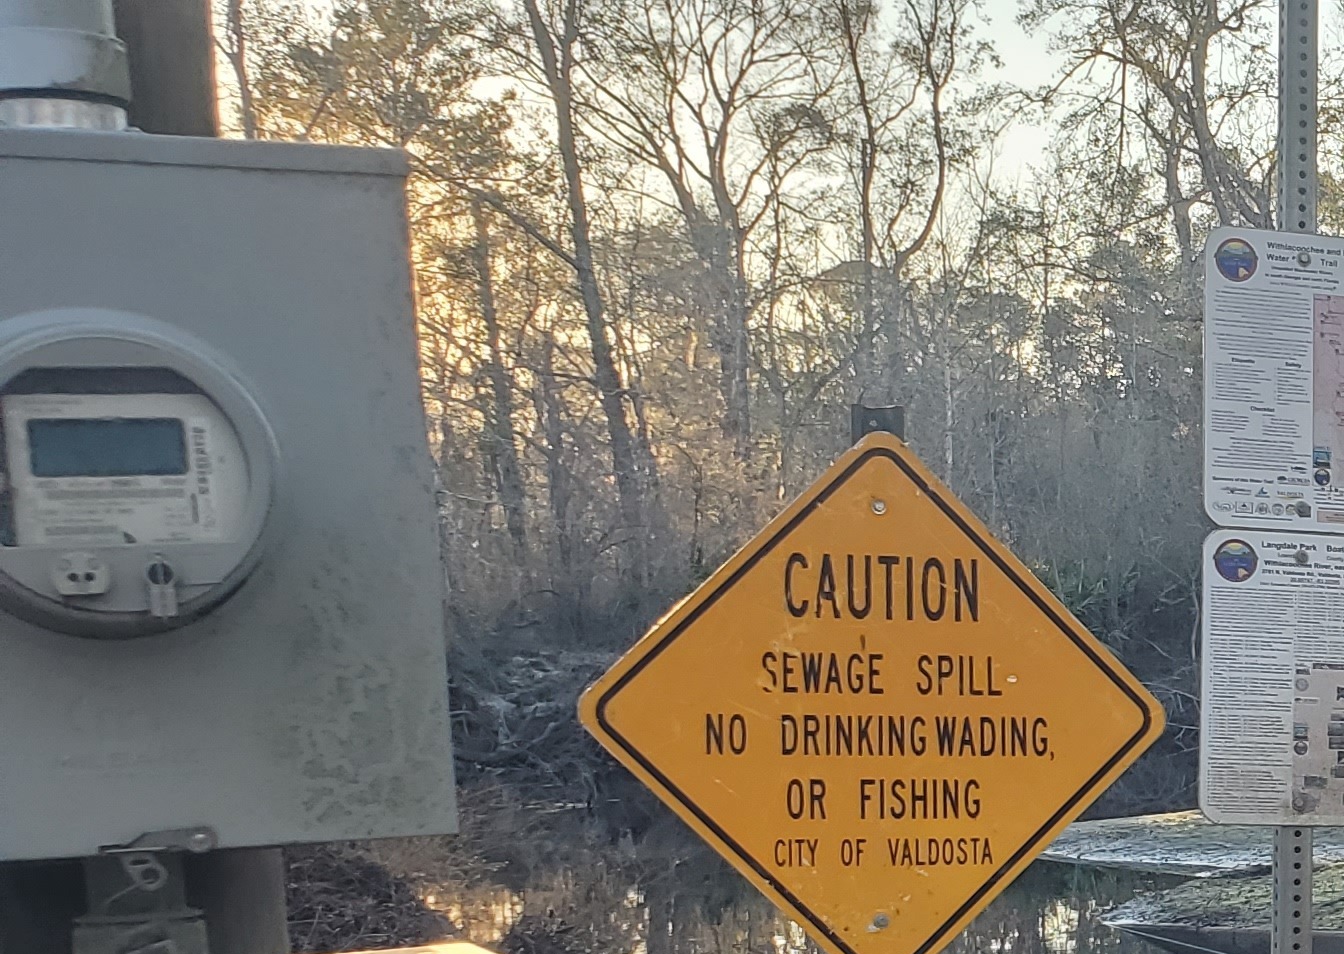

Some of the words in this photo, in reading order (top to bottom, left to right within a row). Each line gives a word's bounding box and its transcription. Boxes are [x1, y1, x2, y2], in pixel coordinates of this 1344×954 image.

[1266, 253, 1290, 263] Water
[1320, 258, 1338, 268] Trail
[1267, 241, 1325, 255] Withlacoochee
[1326, 248, 1341, 257] and
[1261, 540, 1298, 551] Langdale
[1300, 543, 1317, 552] Park
[1326, 545, 1344, 553] Boat
[784, 553, 980, 623] CAUTION
[762, 652, 885, 696] SEWAGE
[916, 655, 1003, 697] SPILL
[705, 714, 748, 756] NO
[780, 715, 928, 757] DRINKING
[935, 716, 1056, 761] WADING,
[786, 779, 827, 820] OR
[860, 779, 982, 820] FISHING
[774, 839, 818, 868] CITY
[840, 839, 866, 867] OF
[888, 838, 994, 867] VALDOSTA
